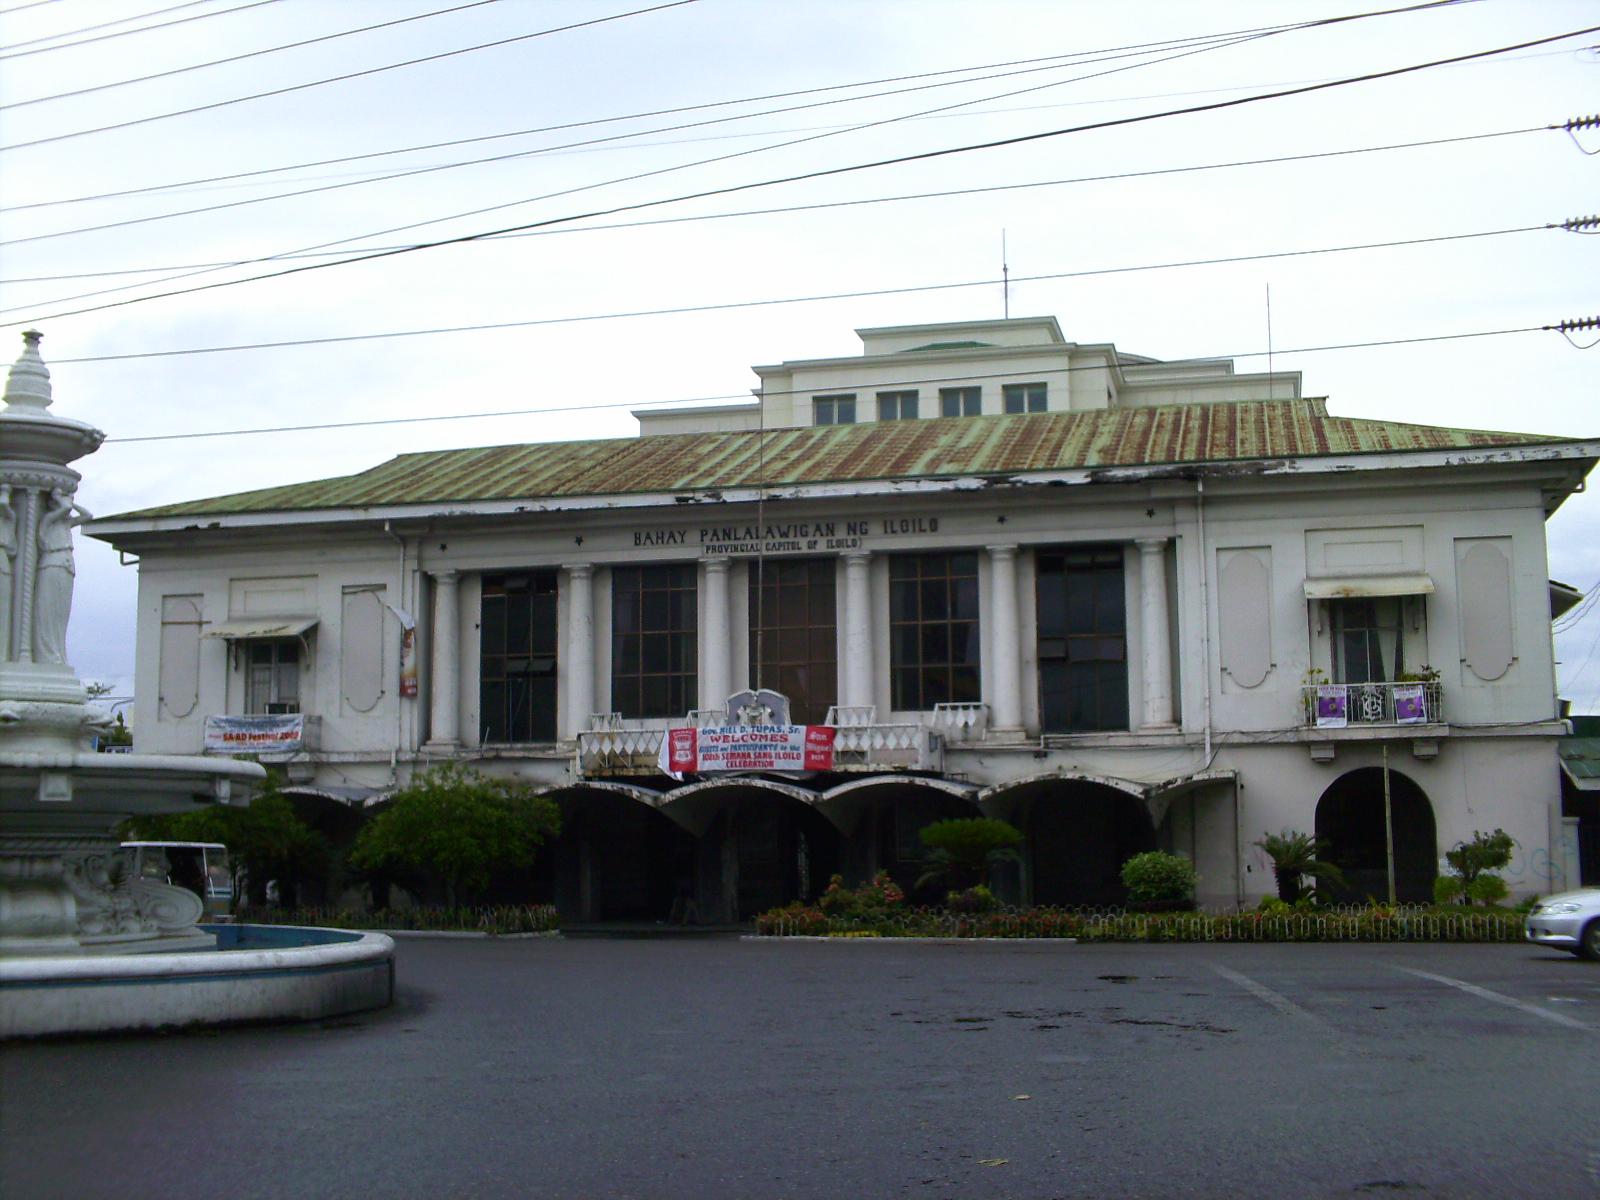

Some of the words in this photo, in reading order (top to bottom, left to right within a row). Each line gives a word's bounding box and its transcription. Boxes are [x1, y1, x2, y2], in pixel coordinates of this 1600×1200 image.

[633, 529, 687, 546] BAHAY
[700, 522, 836, 543] PANLALAWIGAN
[847, 521, 869, 536] NG
[883, 518, 939, 534] ILOILO
[705, 543, 761, 554] PROVINCIAL
[765, 540, 802, 552] CAPITOL
[807, 539, 819, 550] OF
[709, 733, 790, 744] WELCOMES
